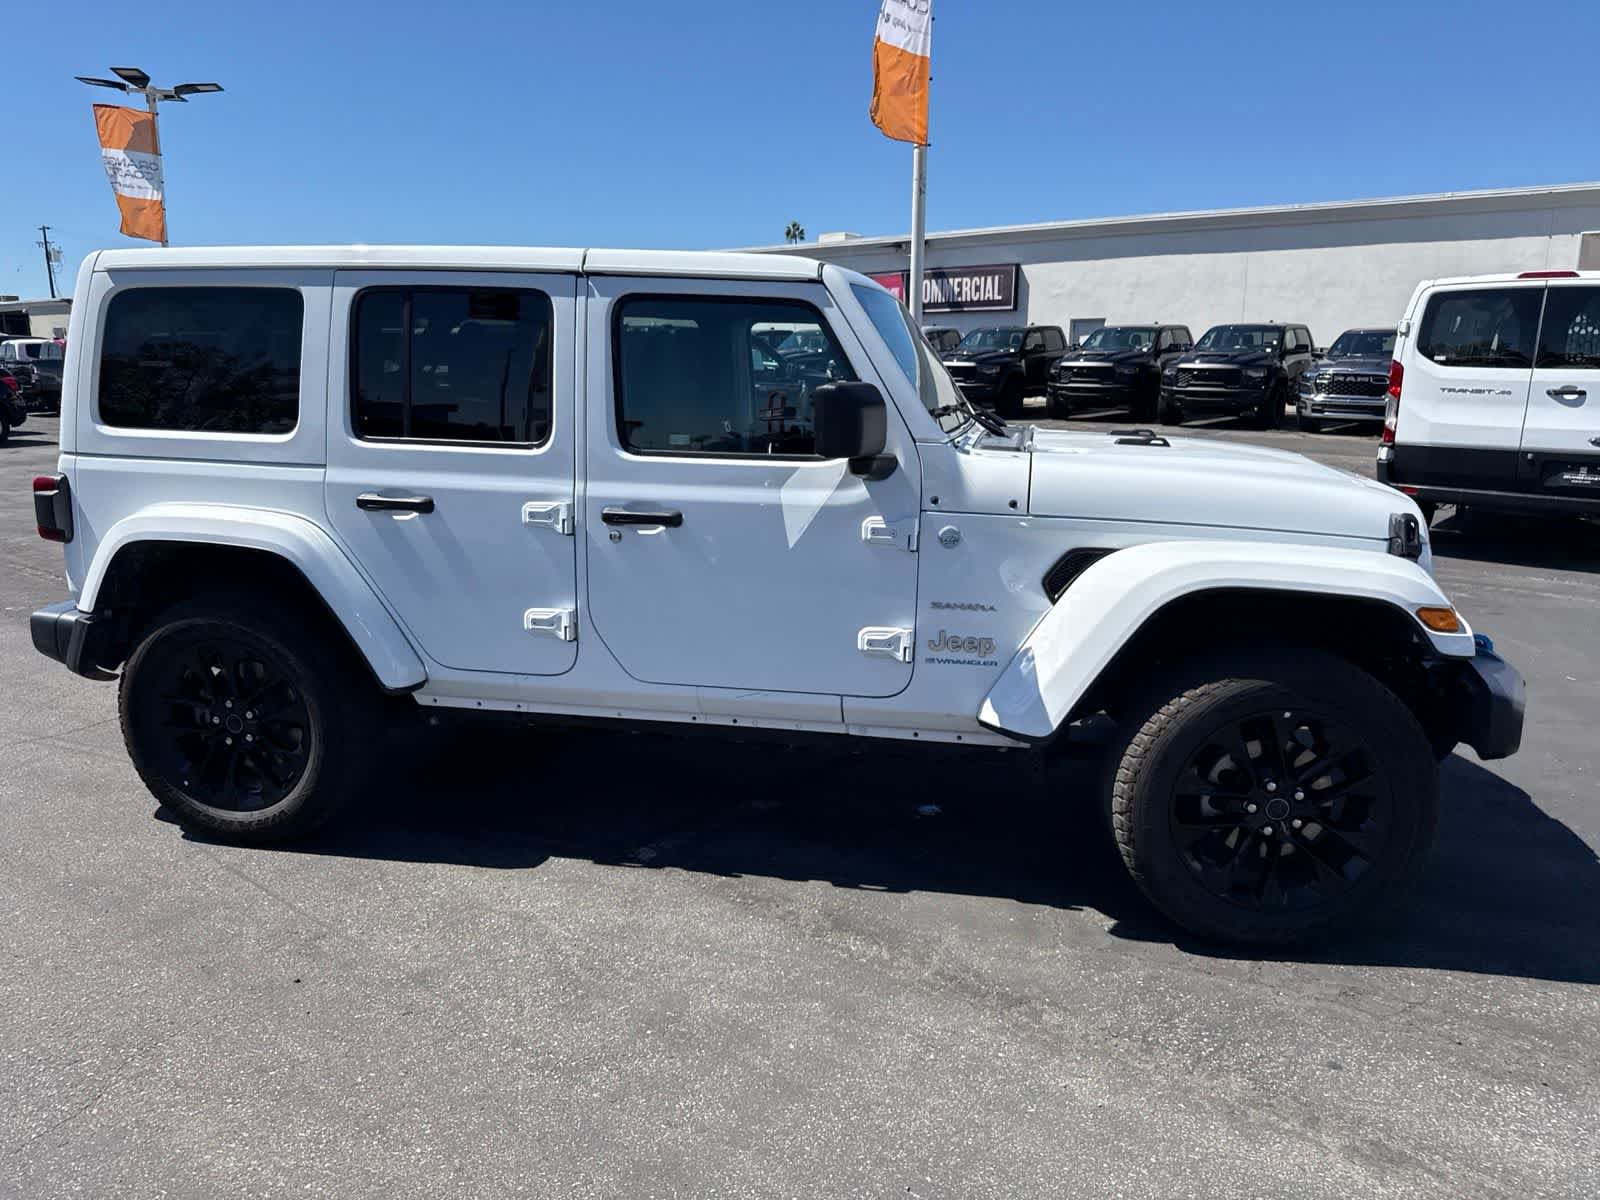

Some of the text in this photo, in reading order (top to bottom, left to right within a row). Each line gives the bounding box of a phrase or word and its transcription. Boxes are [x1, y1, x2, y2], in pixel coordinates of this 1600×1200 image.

[922, 275, 1002, 304] OMMERCIAL
[1440, 387, 1496, 395] TRANSIT
[930, 601, 997, 612] SAHARA
[928, 629, 996, 658] Jeep
[936, 657, 998, 667] WRANGLER
